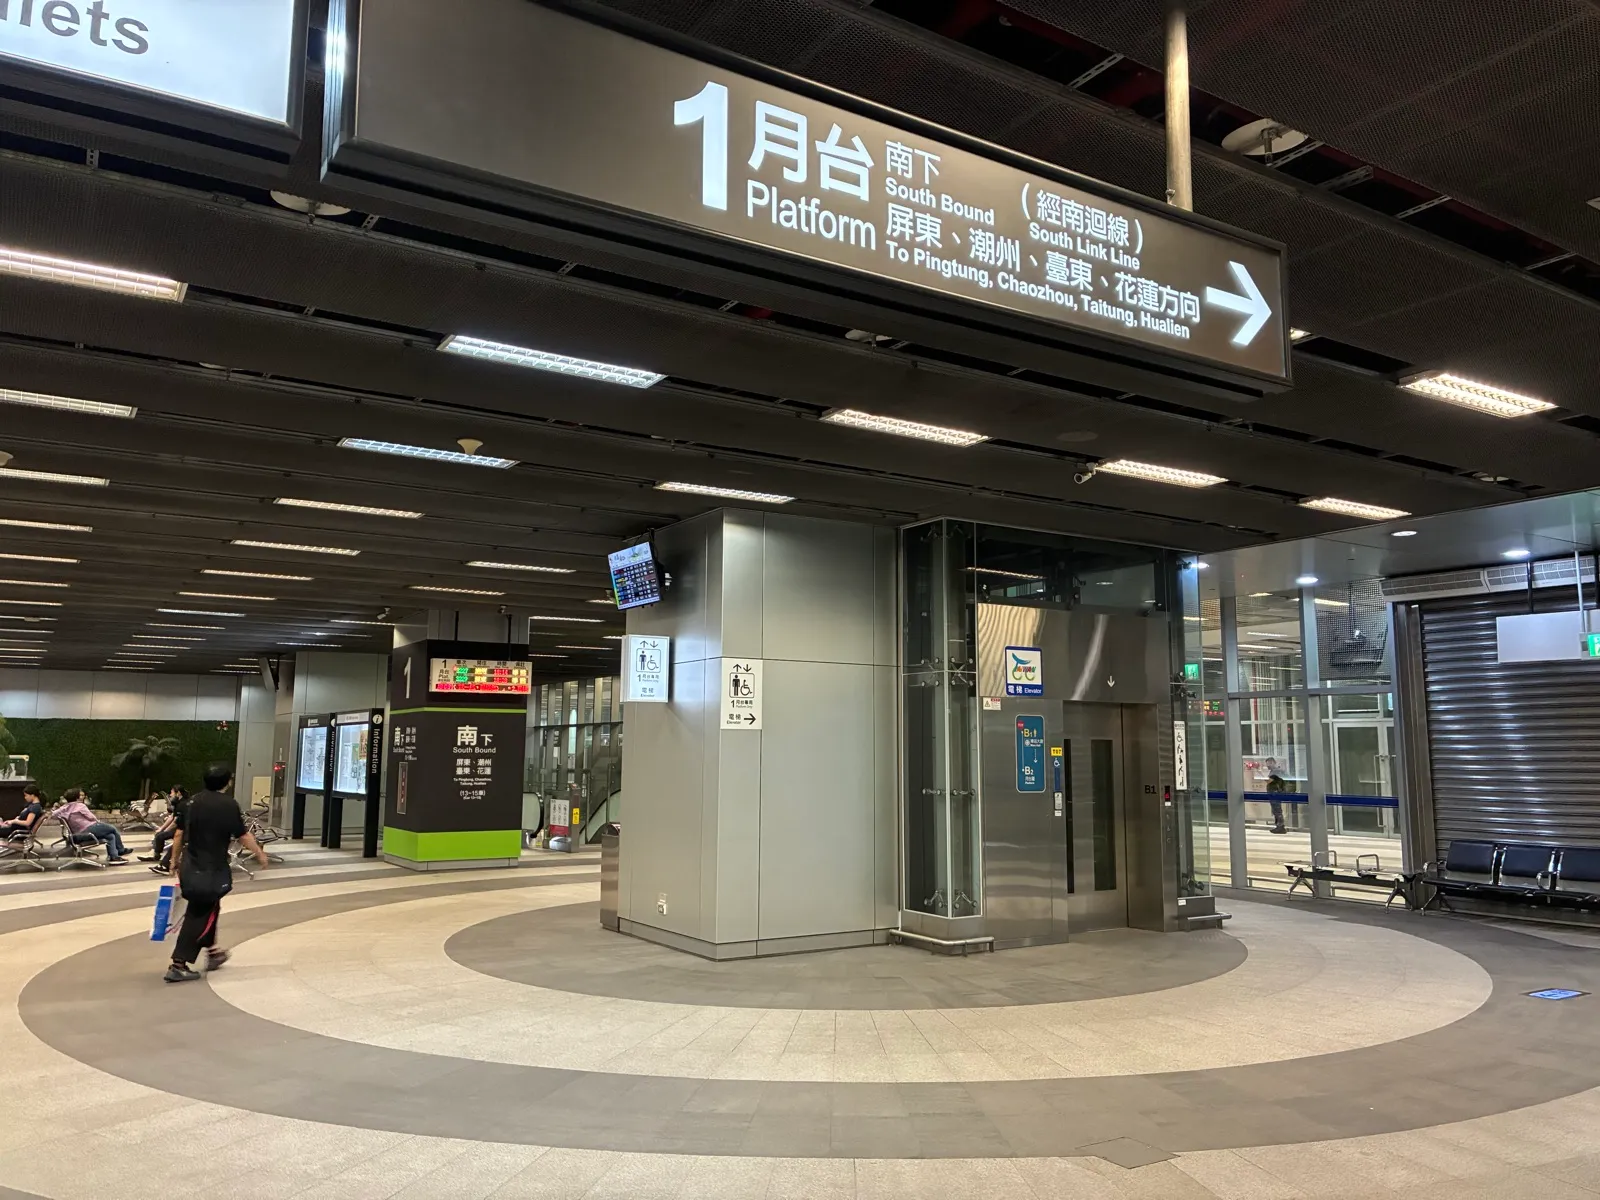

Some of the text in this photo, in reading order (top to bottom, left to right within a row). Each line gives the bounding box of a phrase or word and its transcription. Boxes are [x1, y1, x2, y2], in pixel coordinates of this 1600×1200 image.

[674, 81, 728, 211] 1
[748, 100, 875, 202] 月台
[885, 140, 941, 185] 南下
[747, 179, 876, 250] Platform
[885, 177, 995, 226] South Bound
[1029, 221, 1140, 270] South Link Line
[885, 240, 1191, 339] To Pingtung, Chaozhou, Taitung, Hualien
[404, 657, 412, 699] 1
[441, 659, 447, 669] 1
[637, 674, 642, 682] 1
[731, 700, 735, 708] 1
[1008, 685, 1023, 694] 電梯
[371, 728, 381, 774] Information
[457, 725, 494, 746] 南下
[1024, 766, 1034, 775] B2
[1144, 785, 1157, 794] B1
